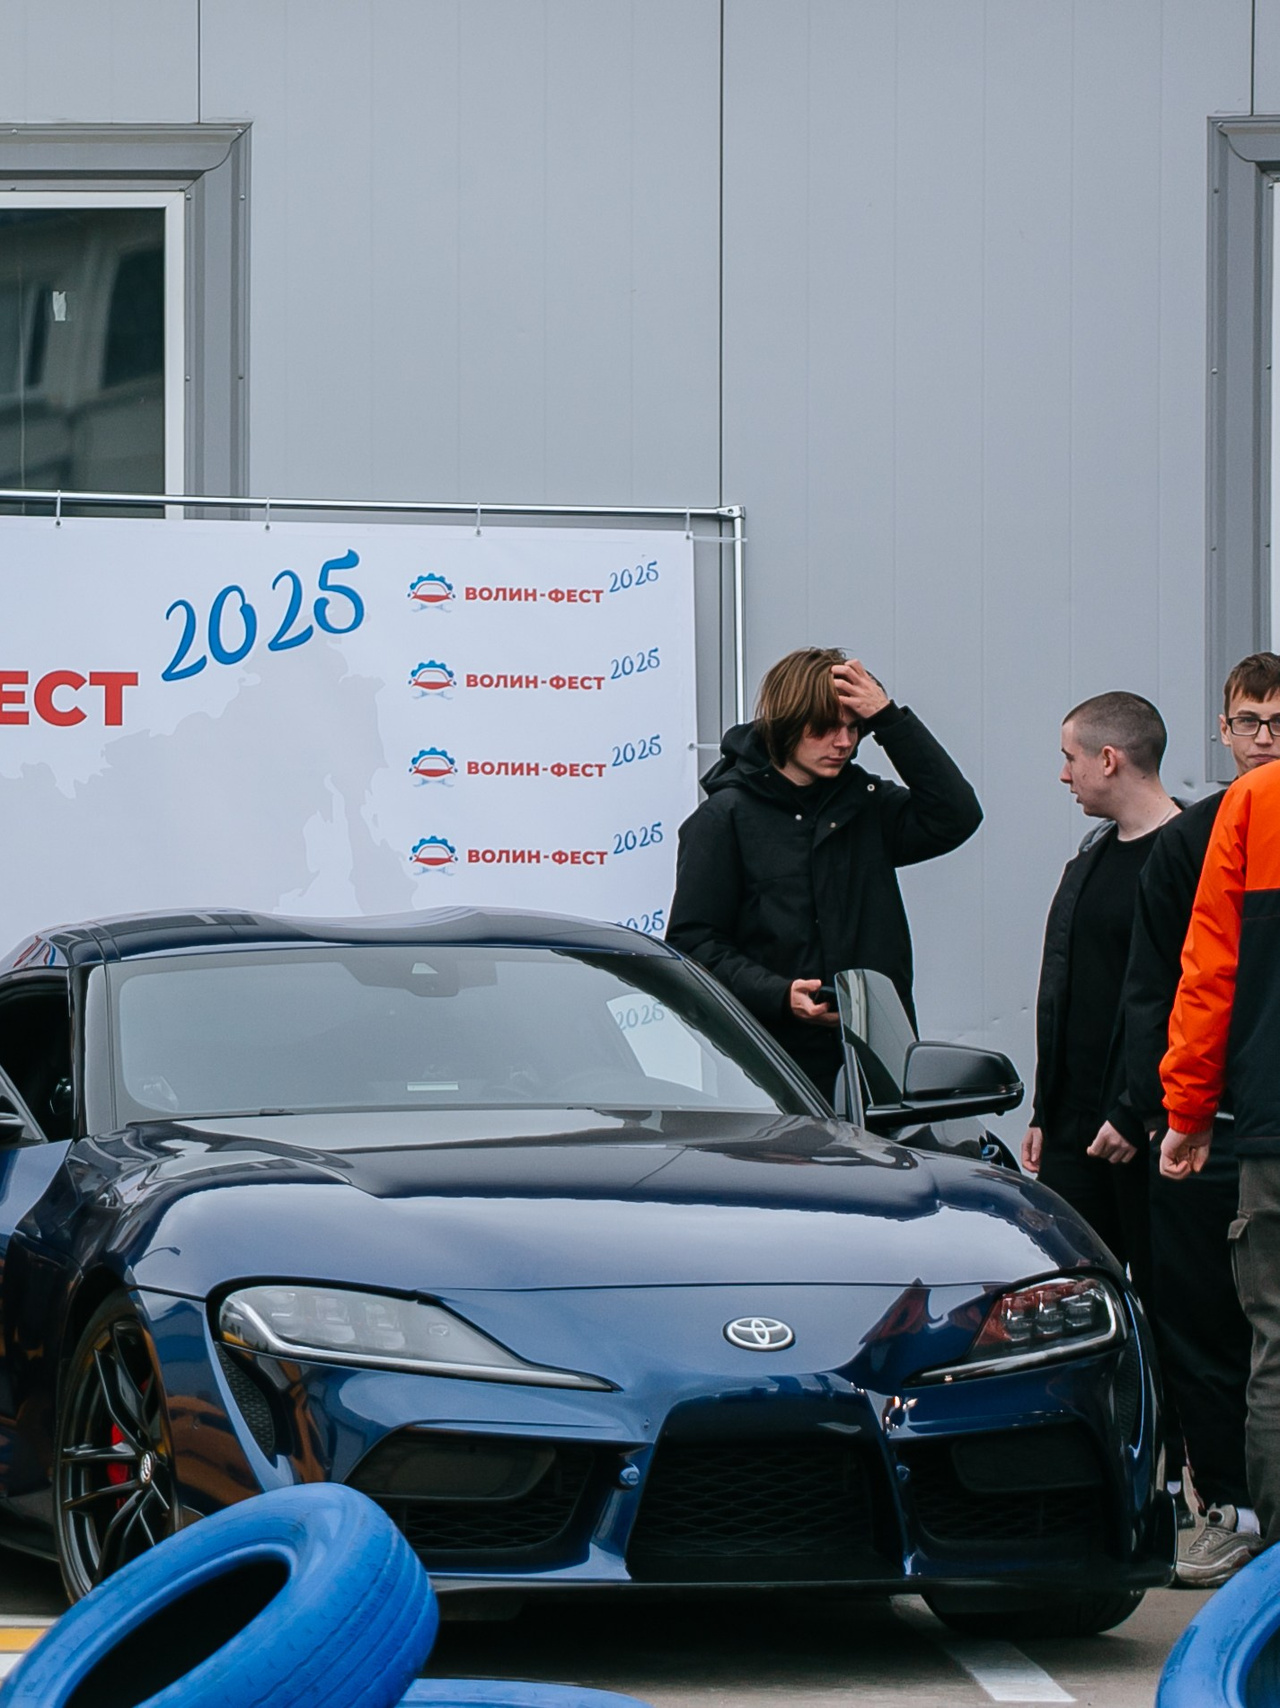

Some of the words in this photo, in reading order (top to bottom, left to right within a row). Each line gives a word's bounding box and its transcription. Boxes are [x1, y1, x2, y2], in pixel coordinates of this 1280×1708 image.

[464, 586, 604, 603] ВОЛИН-ФЕСТ
[608, 561, 659, 593] 2025
[160, 547, 365, 683] 2025
[465, 673, 605, 691] ВОЛИН-ФЕСТ
[610, 648, 661, 680] 2025
[466, 760, 607, 778] ВОЛИН-ФЕСТ
[611, 735, 662, 767] 2025
[467, 848, 608, 866] ВОЛИН-ФЕСТ
[612, 822, 664, 855] 2025
